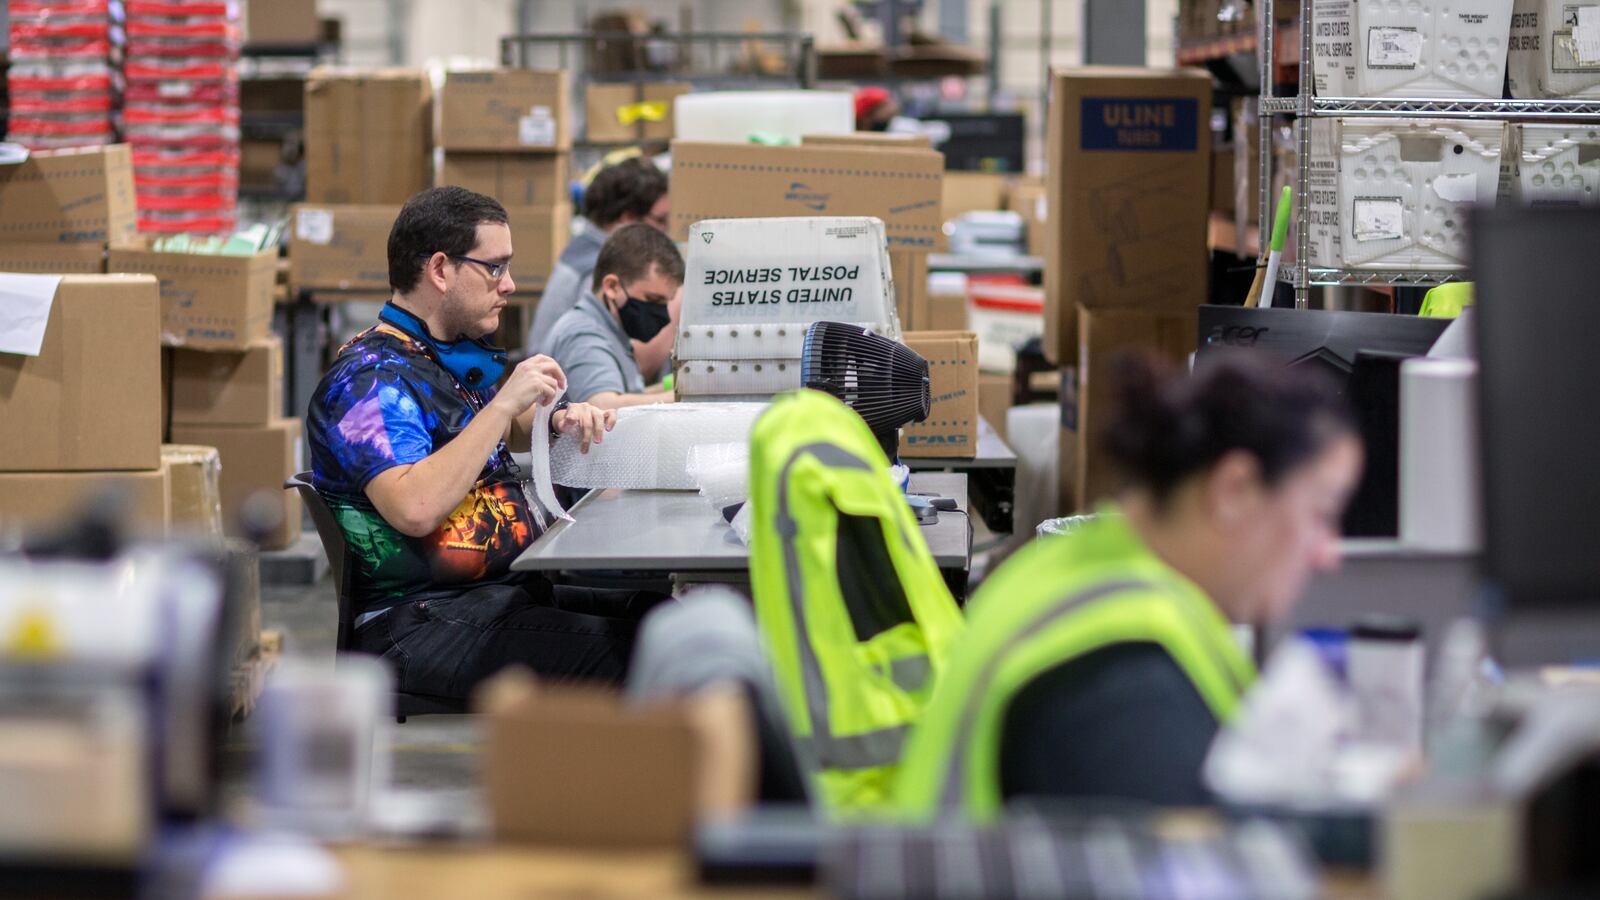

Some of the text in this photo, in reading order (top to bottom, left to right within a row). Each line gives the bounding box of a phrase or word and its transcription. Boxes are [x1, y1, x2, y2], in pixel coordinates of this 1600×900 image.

[1521, 12, 1538, 28] STATES
[1316, 21, 1350, 37] UNITED STATES
[1315, 42, 1353, 57] POSTAL SERVICE
[1521, 36, 1540, 50] SERVICE
[1104, 103, 1175, 128] ULINE
[1321, 191, 1337, 206] STATES
[1322, 211, 1339, 226] SERVICE
[704, 265, 860, 285] POSTAL SERVICE
[711, 287, 853, 306] UNITED STATES
[1207, 324, 1269, 347] acer
